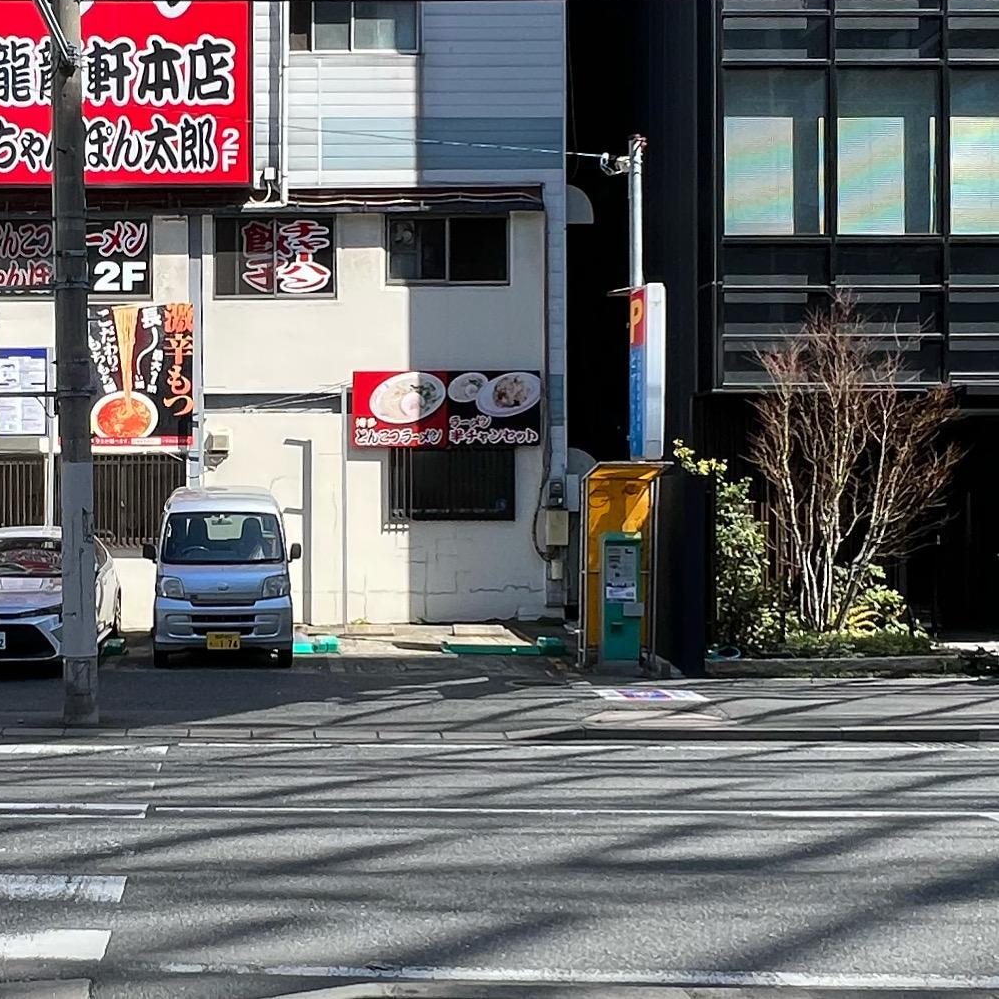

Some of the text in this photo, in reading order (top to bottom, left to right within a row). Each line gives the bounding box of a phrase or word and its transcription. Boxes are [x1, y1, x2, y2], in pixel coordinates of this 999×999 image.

[93, 261, 147, 292] 2F
[630, 299, 644, 344] P
[355, 428, 443, 446] とんこつラーメン
